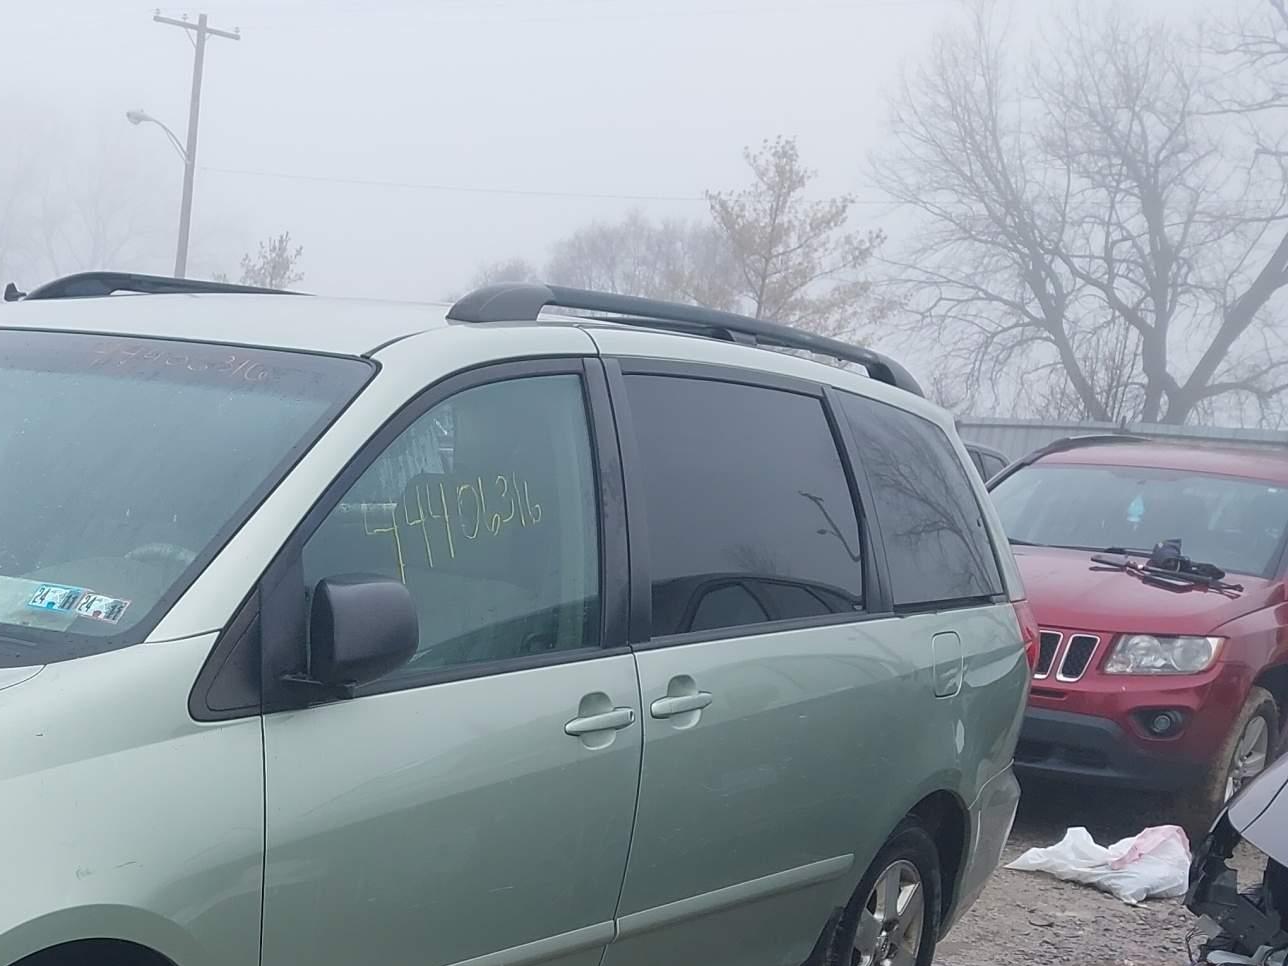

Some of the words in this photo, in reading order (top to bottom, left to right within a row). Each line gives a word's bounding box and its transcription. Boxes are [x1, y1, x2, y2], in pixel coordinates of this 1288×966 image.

[363, 472, 543, 585] 44406316
[31, 587, 52, 604] 24
[78, 594, 98, 612] 24
